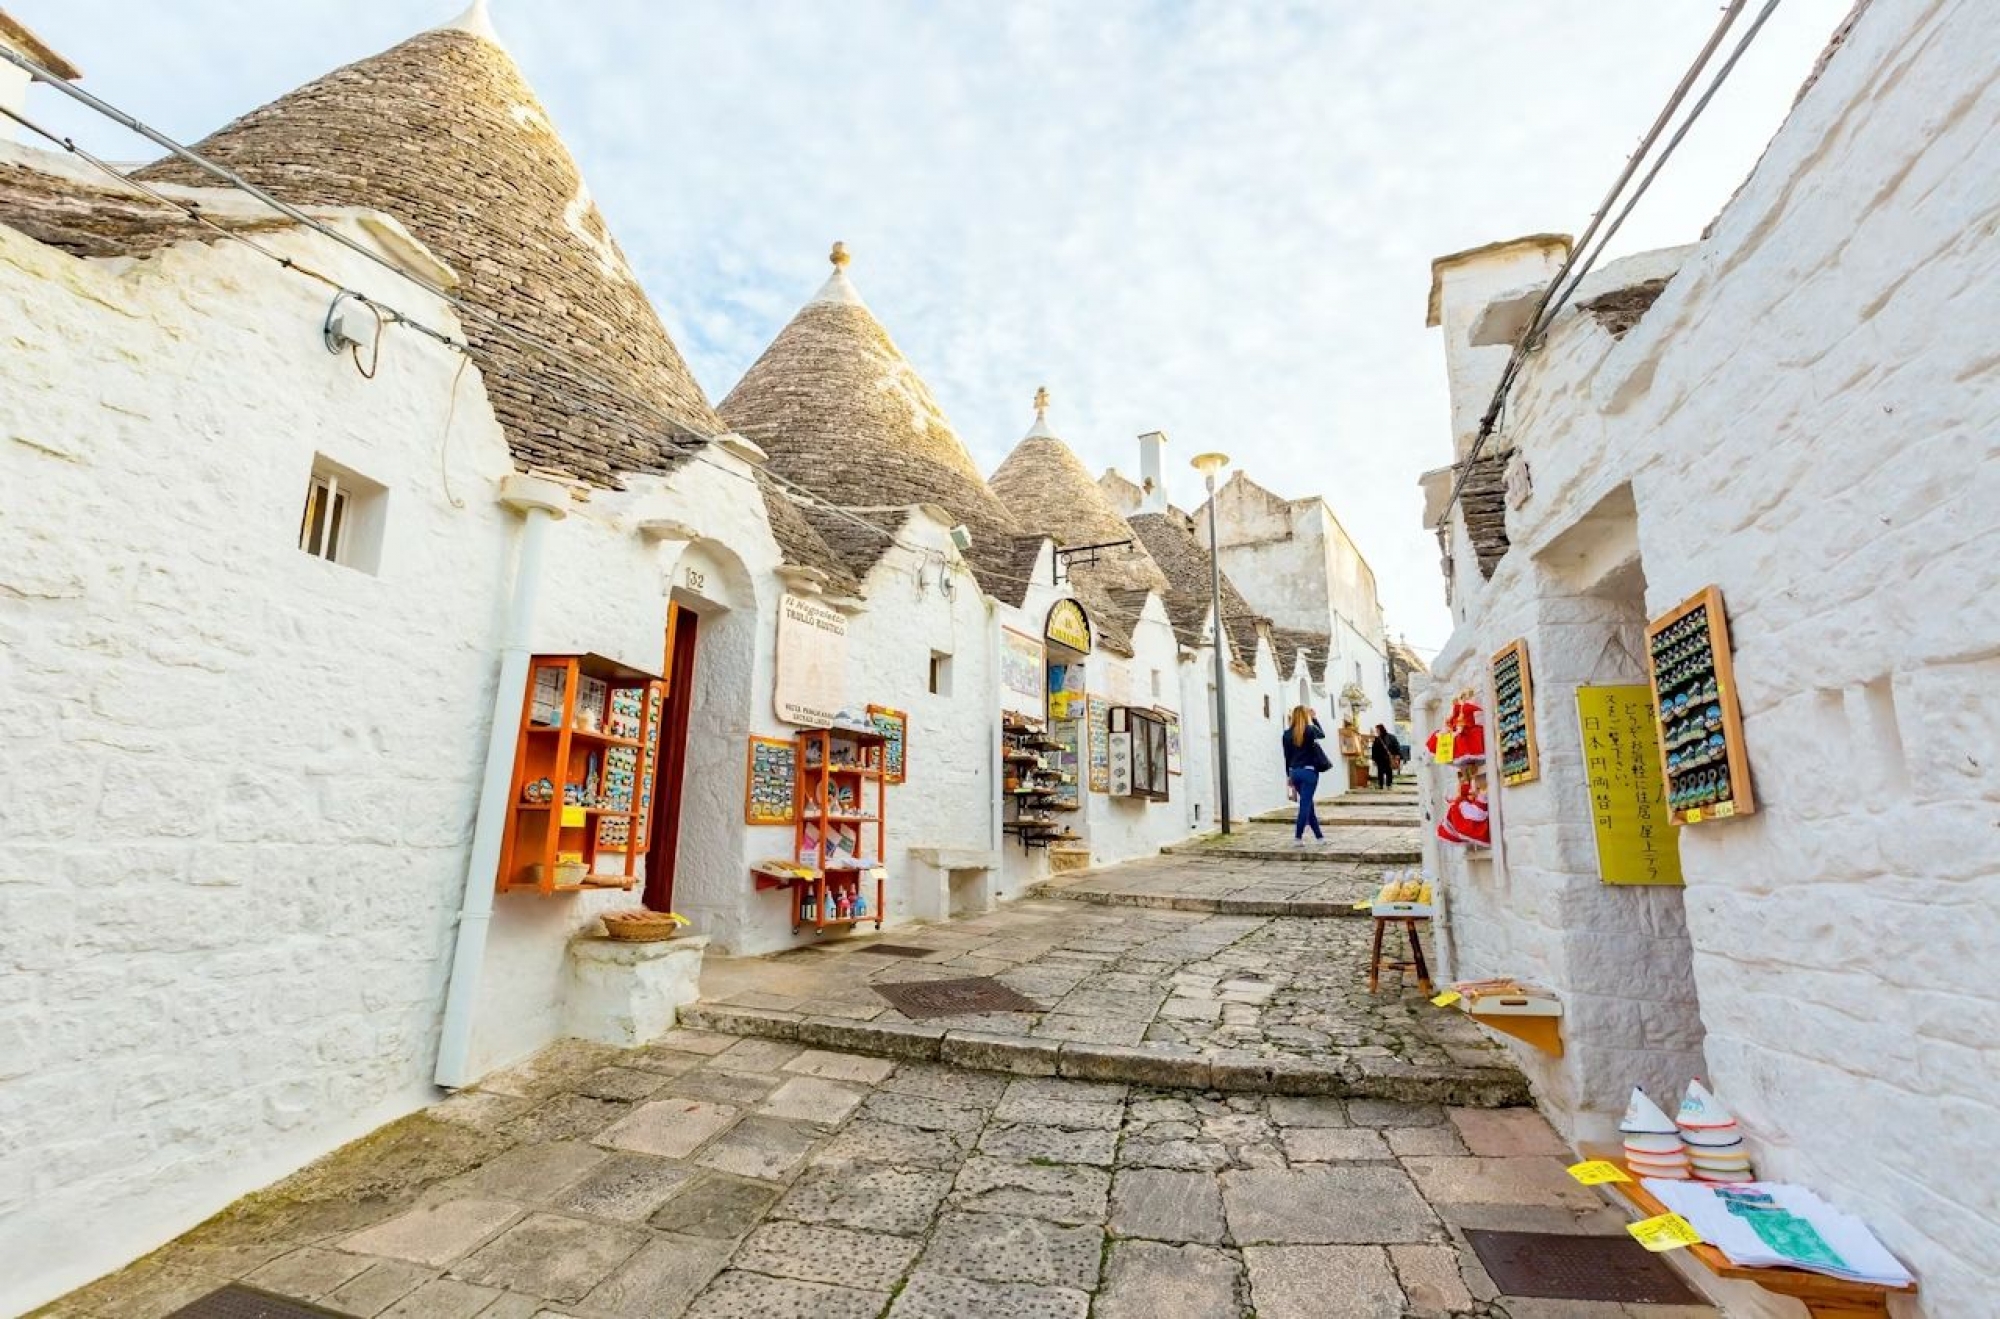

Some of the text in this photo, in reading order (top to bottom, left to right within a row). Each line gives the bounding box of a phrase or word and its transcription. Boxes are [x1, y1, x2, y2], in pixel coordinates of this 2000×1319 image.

[785, 607, 815, 626] TRULLO
[1585, 716, 1612, 829] 日本円両替可
